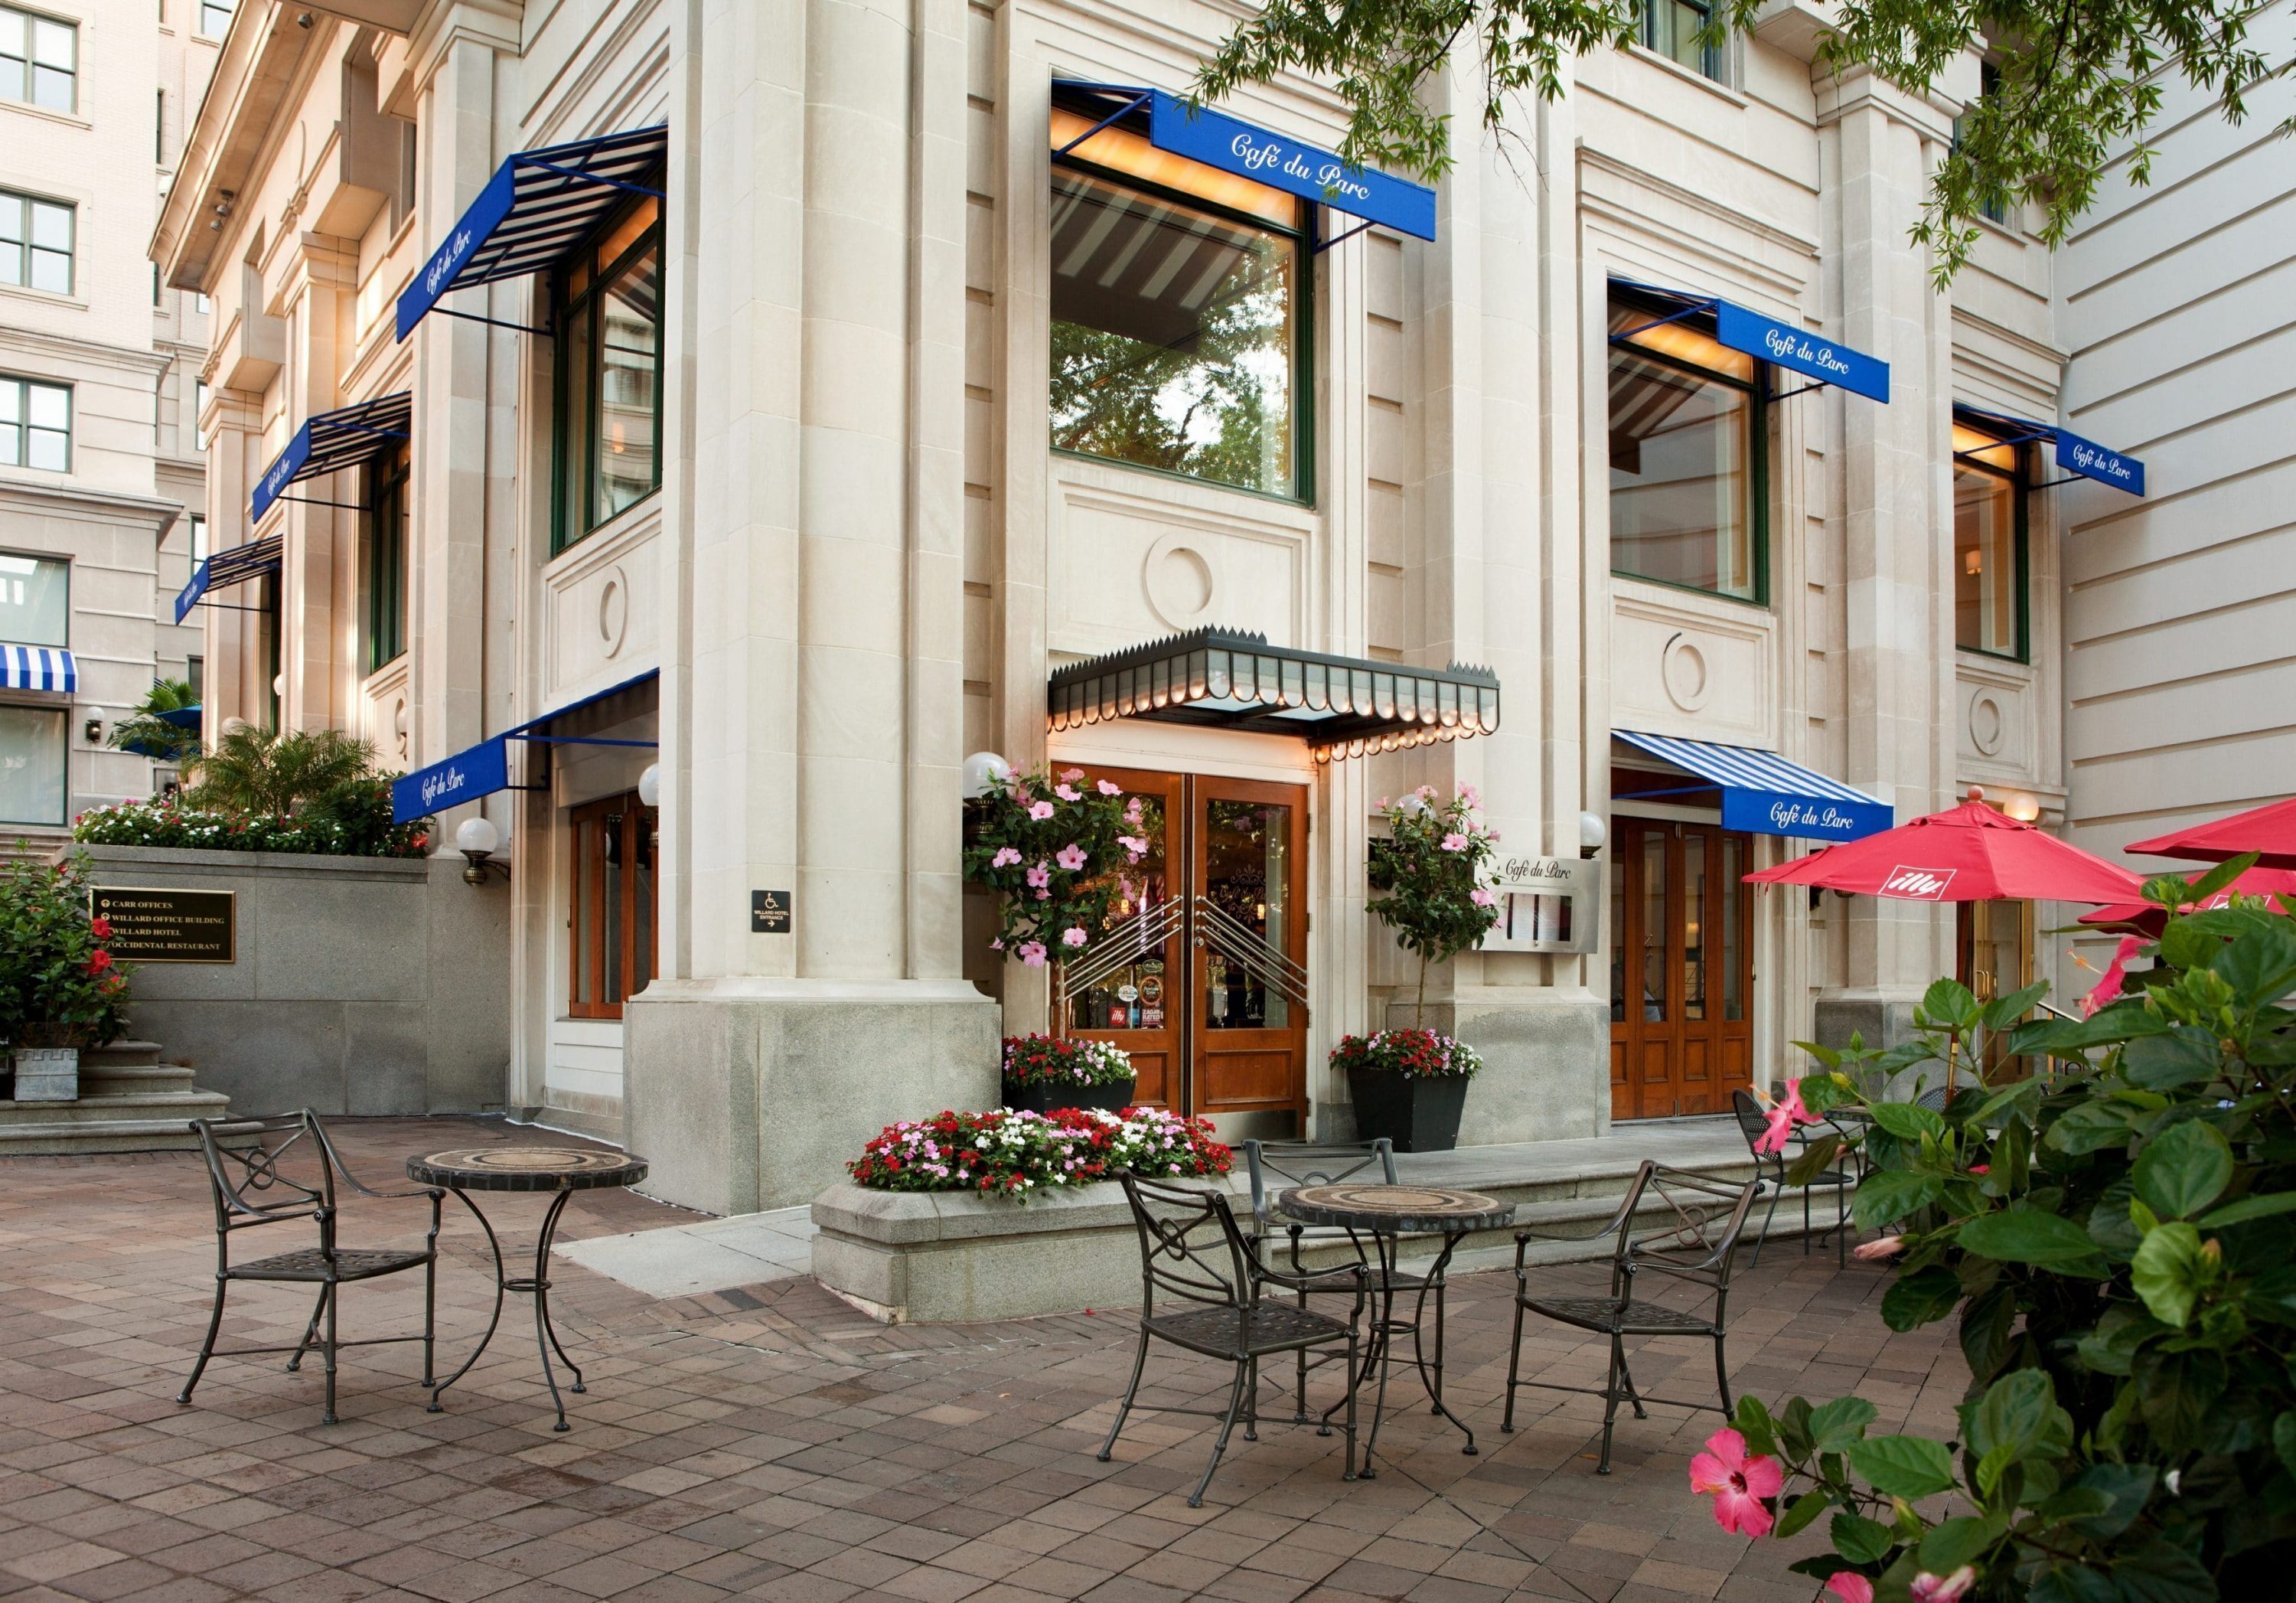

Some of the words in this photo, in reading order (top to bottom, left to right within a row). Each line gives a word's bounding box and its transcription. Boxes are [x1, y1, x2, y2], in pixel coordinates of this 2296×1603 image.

[1231, 134, 1280, 170] Café
[1283, 154, 1312, 180] du
[1316, 165, 1370, 200] Parc
[426, 256, 442, 295] Café
[1766, 329, 1796, 357] Café
[1797, 341, 1815, 361] du
[1816, 348, 1850, 375] Parc
[2073, 444, 2094, 468] Café
[2095, 453, 2107, 470] du
[2107, 459, 2131, 479] Parc
[422, 775, 437, 807] Café
[437, 772, 445, 795] du
[446, 767, 465, 792] Parc
[1770, 802, 1801, 829] Café
[1802, 805, 1818, 825] du
[1820, 807, 1854, 829] Parc
[1505, 857, 1530, 883] Café
[1531, 860, 1544, 877] du
[1544, 861, 1571, 880] Parc
[1887, 872, 1944, 896] illy
[1111, 1010, 1124, 1023] illy
